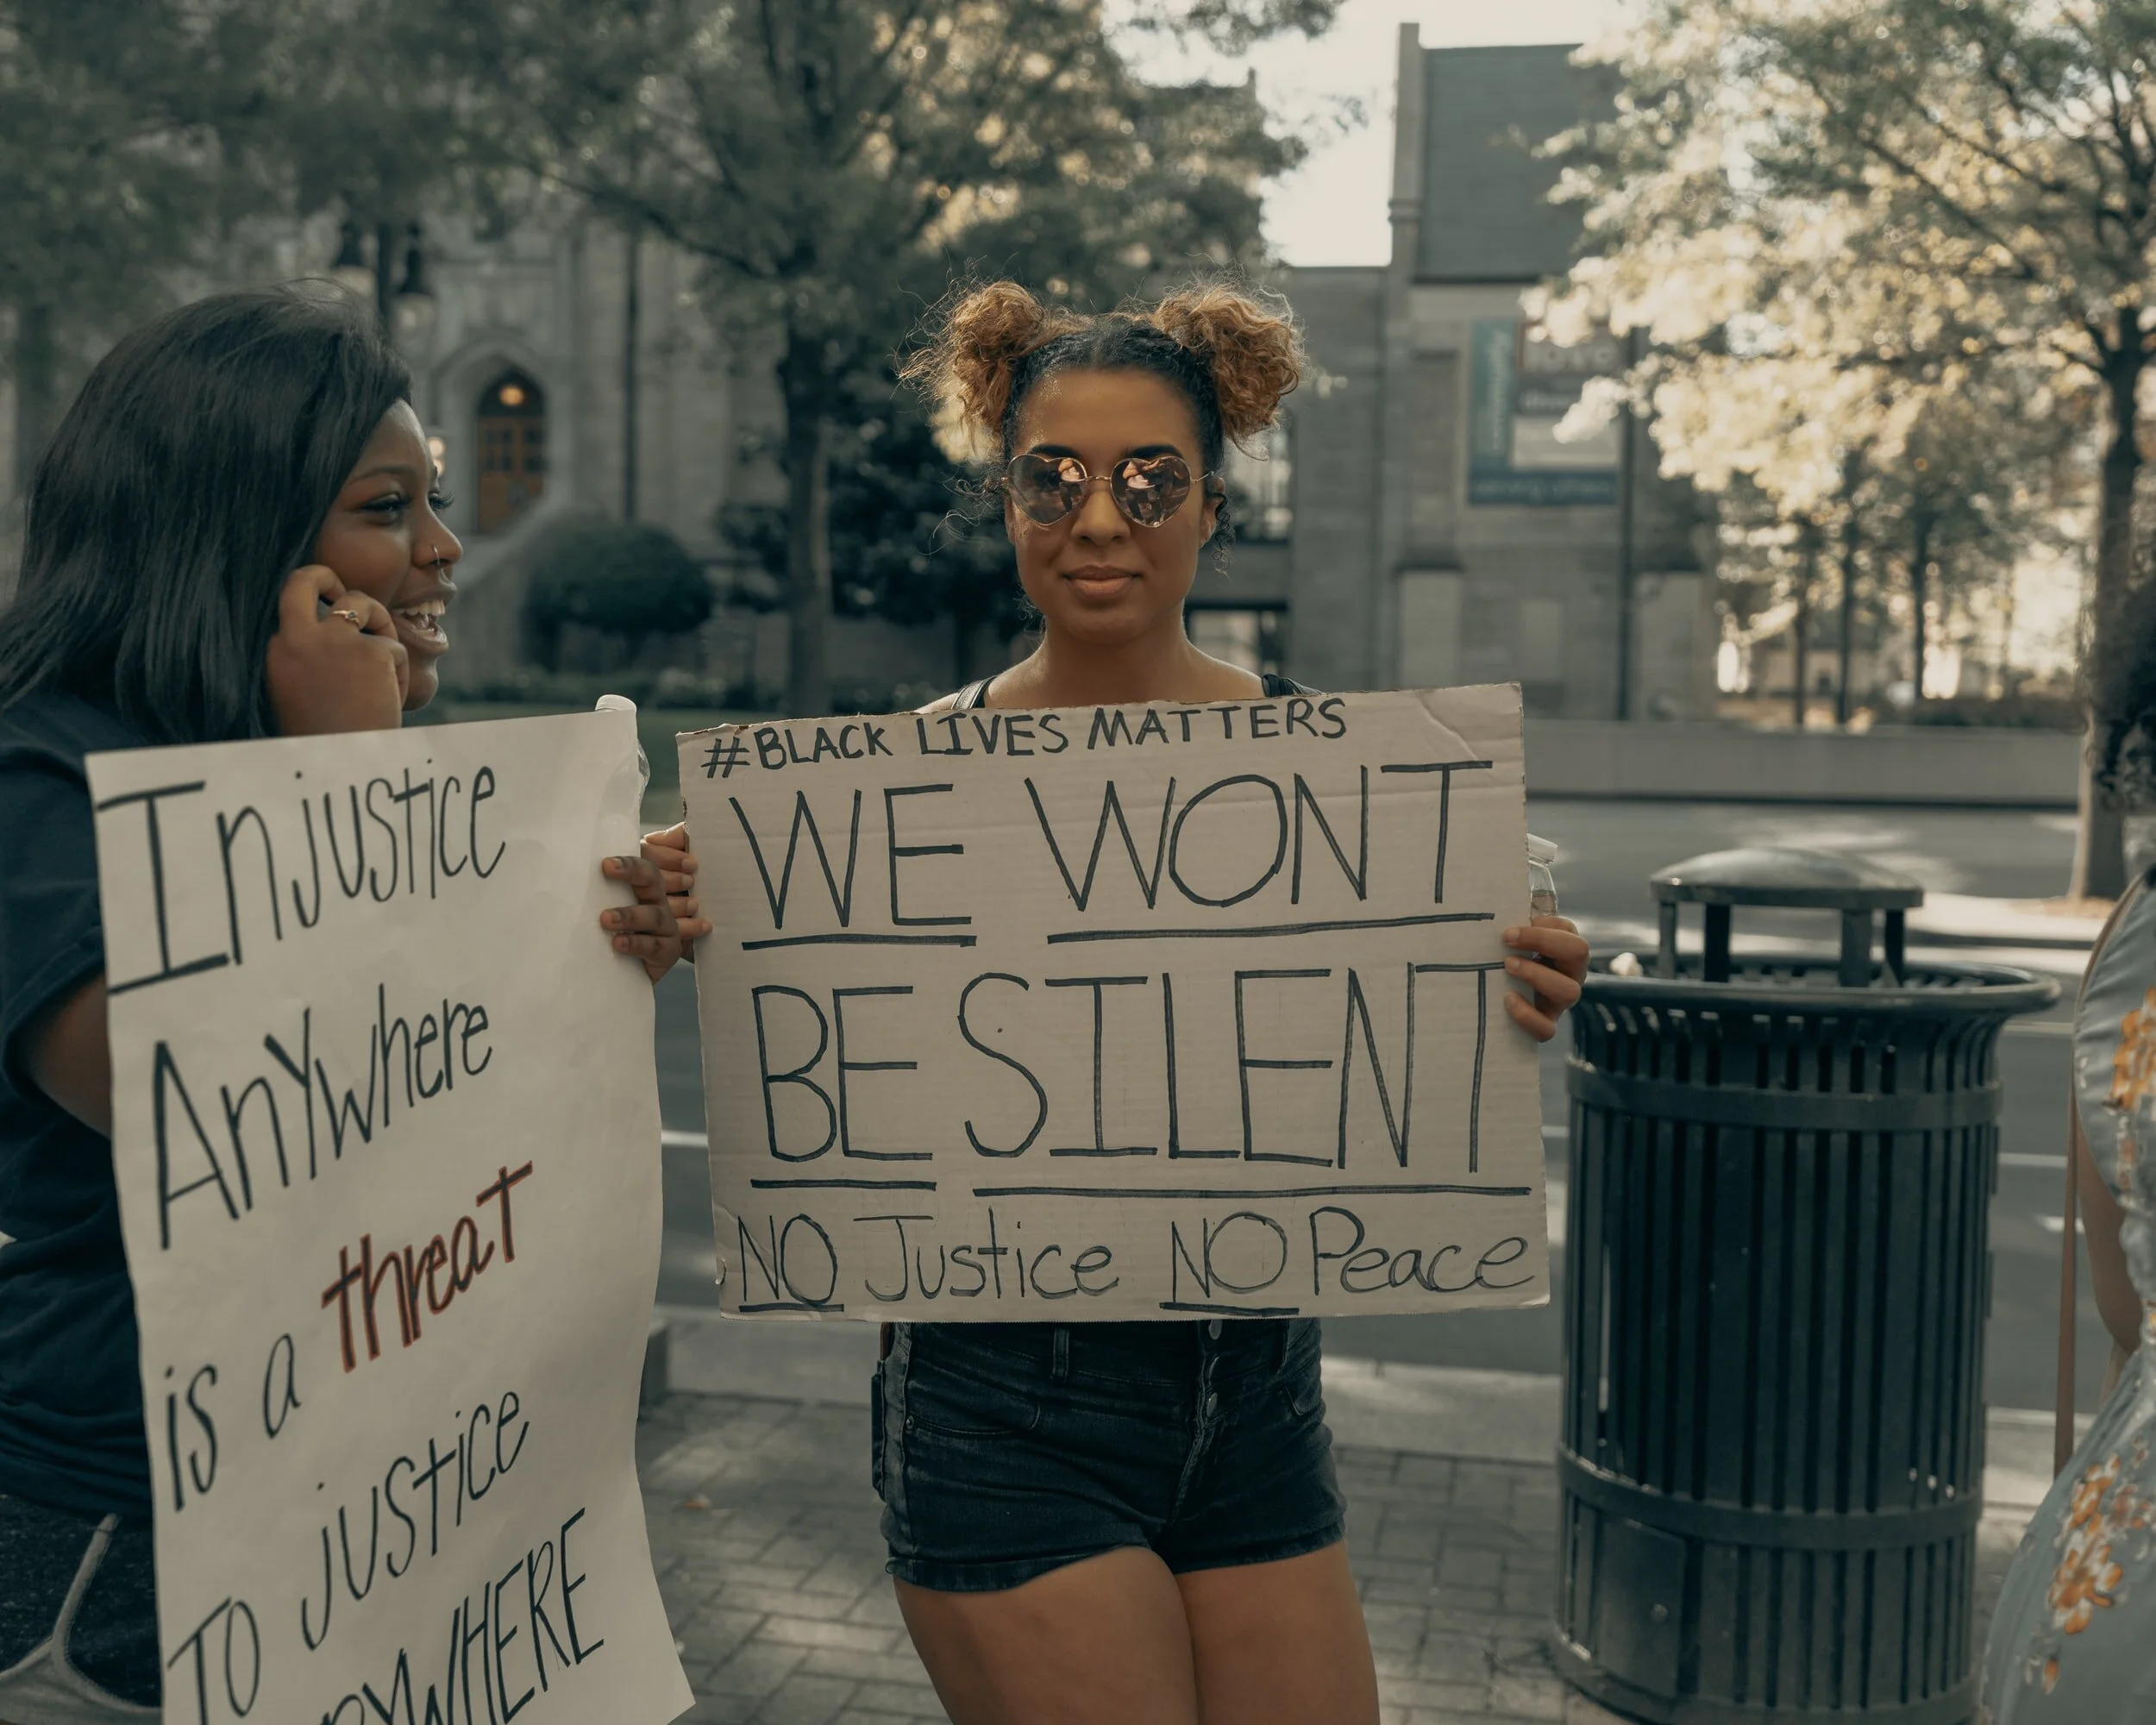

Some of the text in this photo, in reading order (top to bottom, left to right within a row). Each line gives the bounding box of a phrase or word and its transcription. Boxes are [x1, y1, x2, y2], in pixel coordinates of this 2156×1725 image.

[700, 697, 1348, 779] #BLACK LIVES MATTERS
[97, 758, 506, 996] Injustice
[728, 760, 1494, 931] WE WONT
[750, 962, 1509, 1174] BE SILENT
[737, 1205, 1537, 1306] NO Justice NO Peace
[164, 1365, 218, 1513] is
[264, 1333, 302, 1440] a
[167, 1390, 530, 1725] TO justice
[320, 1507, 604, 1725] YWHERE
